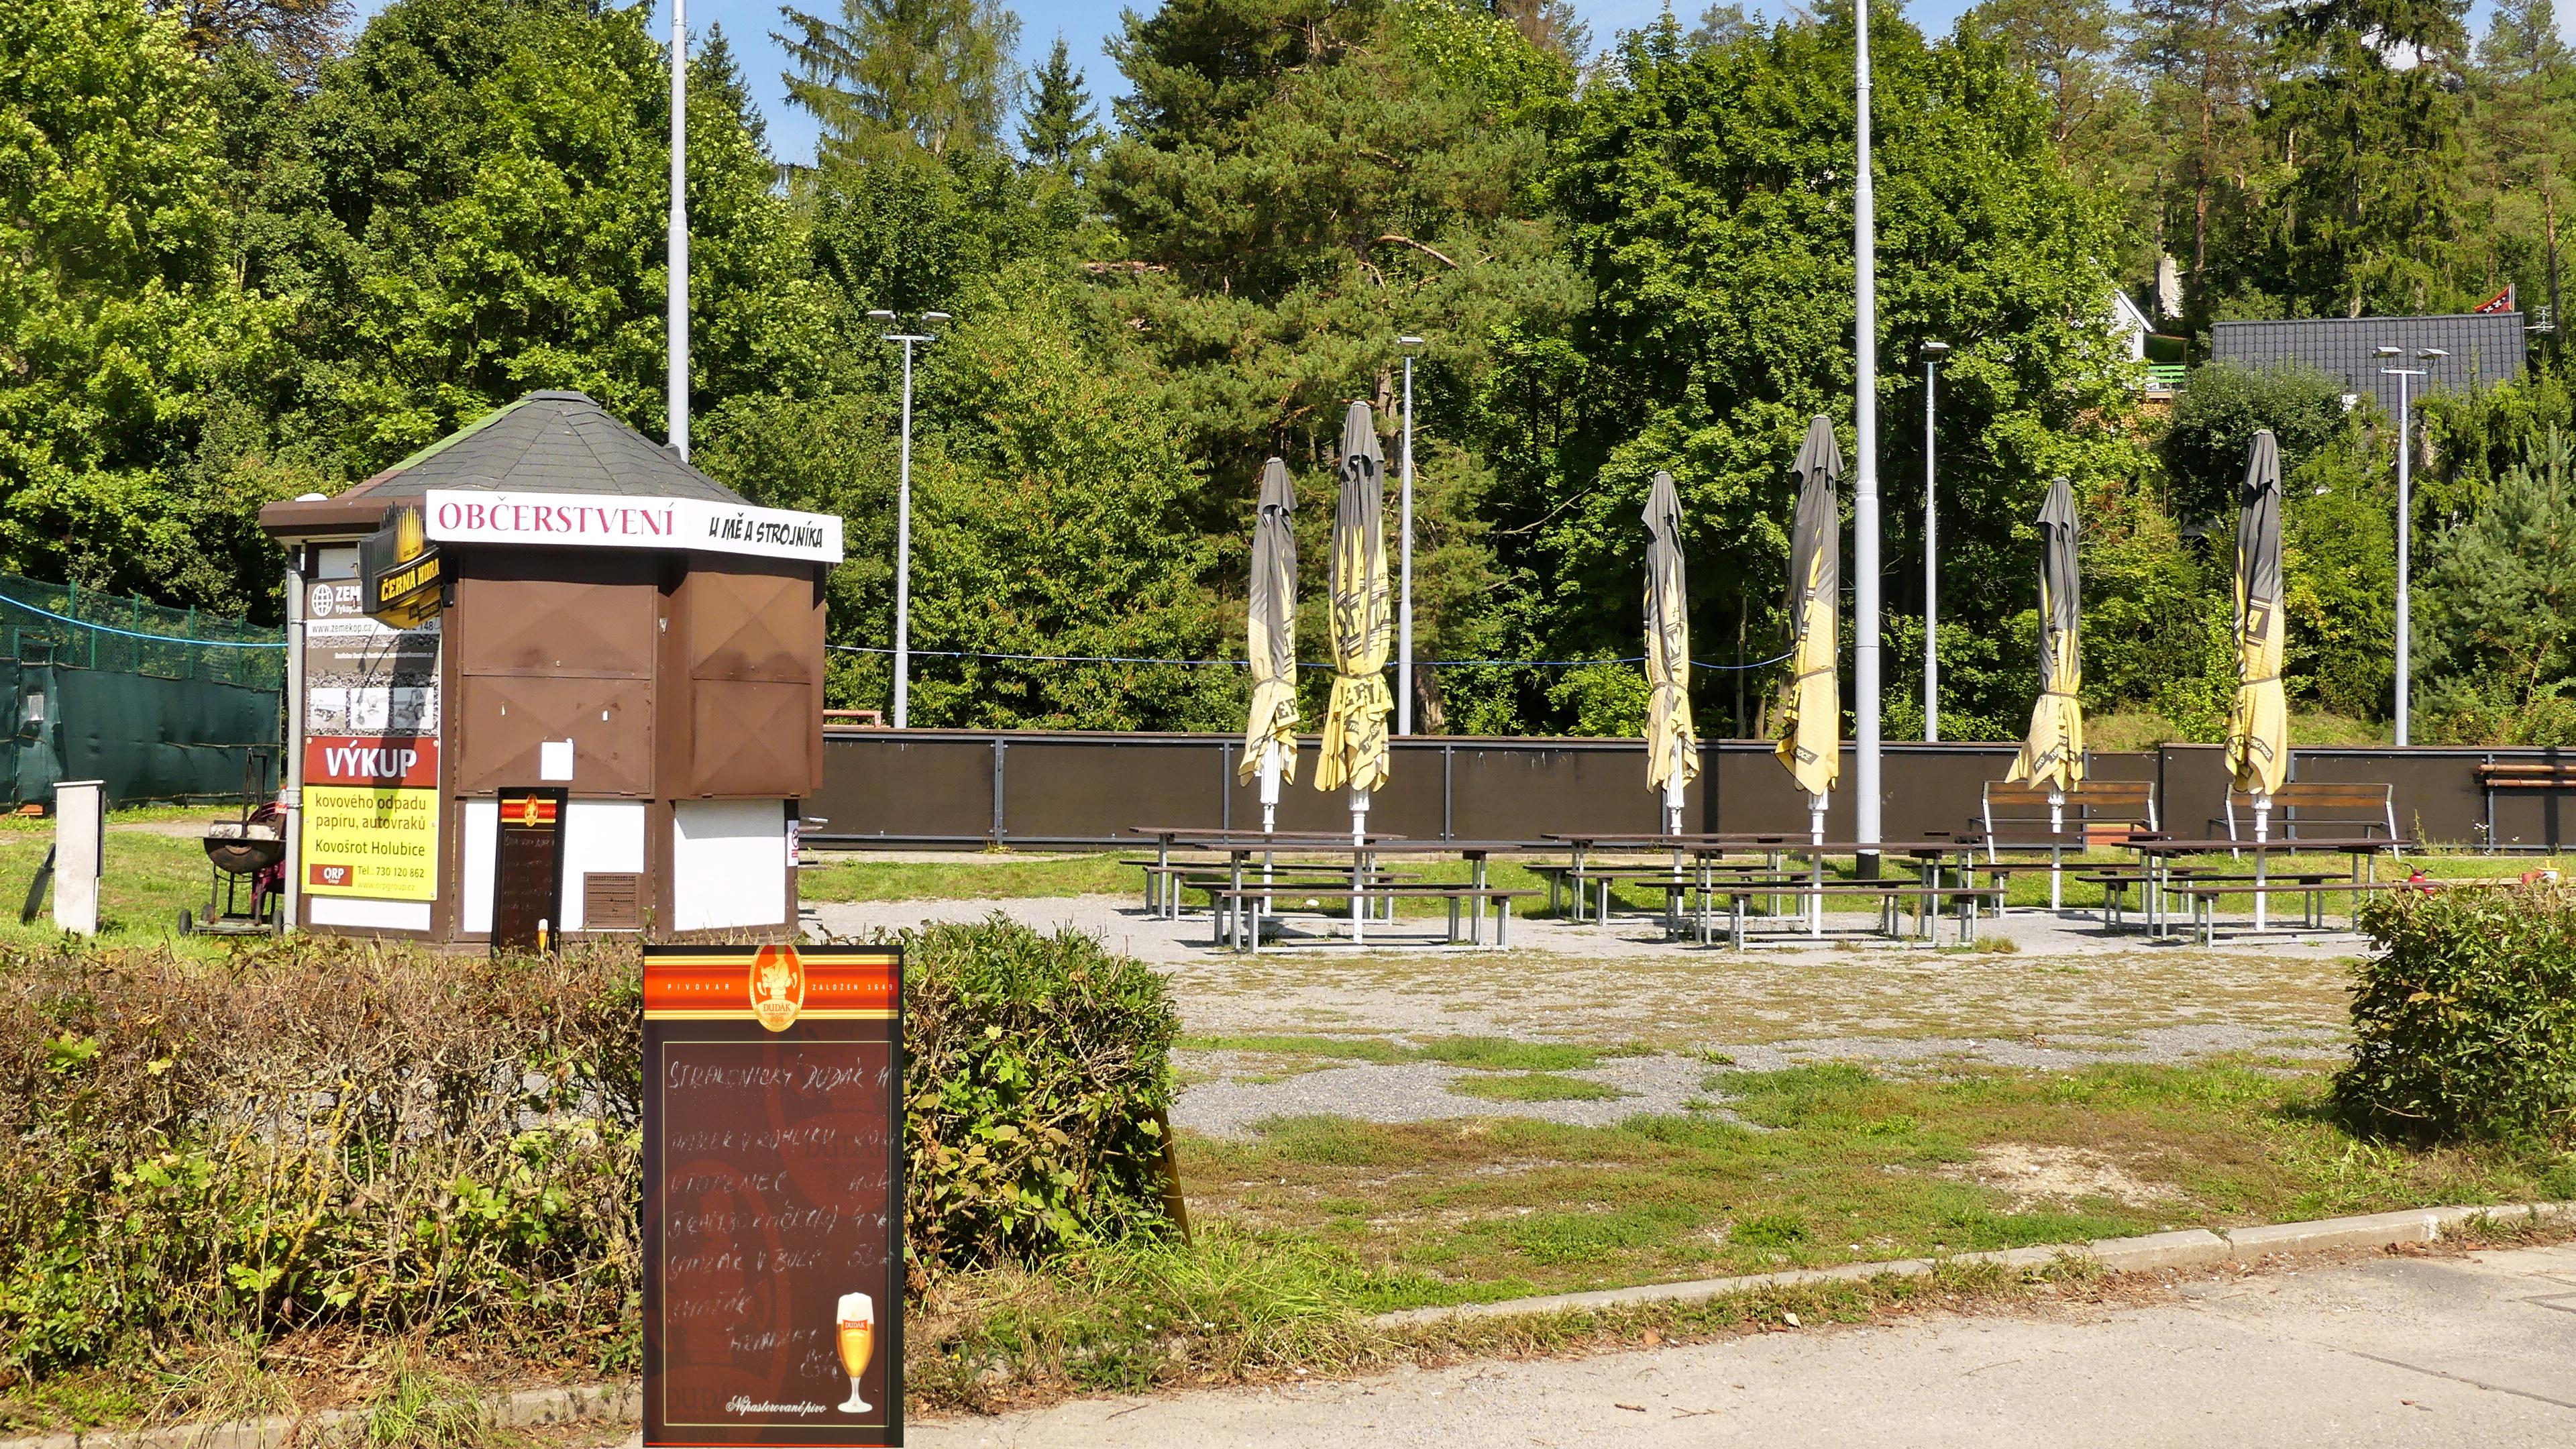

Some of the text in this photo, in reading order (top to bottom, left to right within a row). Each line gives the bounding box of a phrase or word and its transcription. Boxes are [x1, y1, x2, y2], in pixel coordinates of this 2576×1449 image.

[438, 495, 674, 536] OBČERSTVENÍ
[708, 513, 823, 548] U MĚ A STROJNÍKA
[381, 558, 440, 602] ČERNÁ HORA
[312, 623, 372, 633] www.zemekop.cz
[325, 739, 417, 778] VÝKUP
[315, 793, 426, 813] kovového odpadu
[316, 814, 425, 831] papíru, autovraků
[315, 839, 425, 857] Kovošrot Holubice
[323, 867, 345, 879] ORP
[376, 867, 391, 877] 730
[394, 867, 407, 877] 120
[409, 868, 425, 878] 862
[357, 881, 415, 892] www.orpgroup.cz
[812, 982, 859, 991] ZALOŽEN
[763, 1002, 792, 1013] DUDÁK
[800, 1401, 827, 1417] pivo
